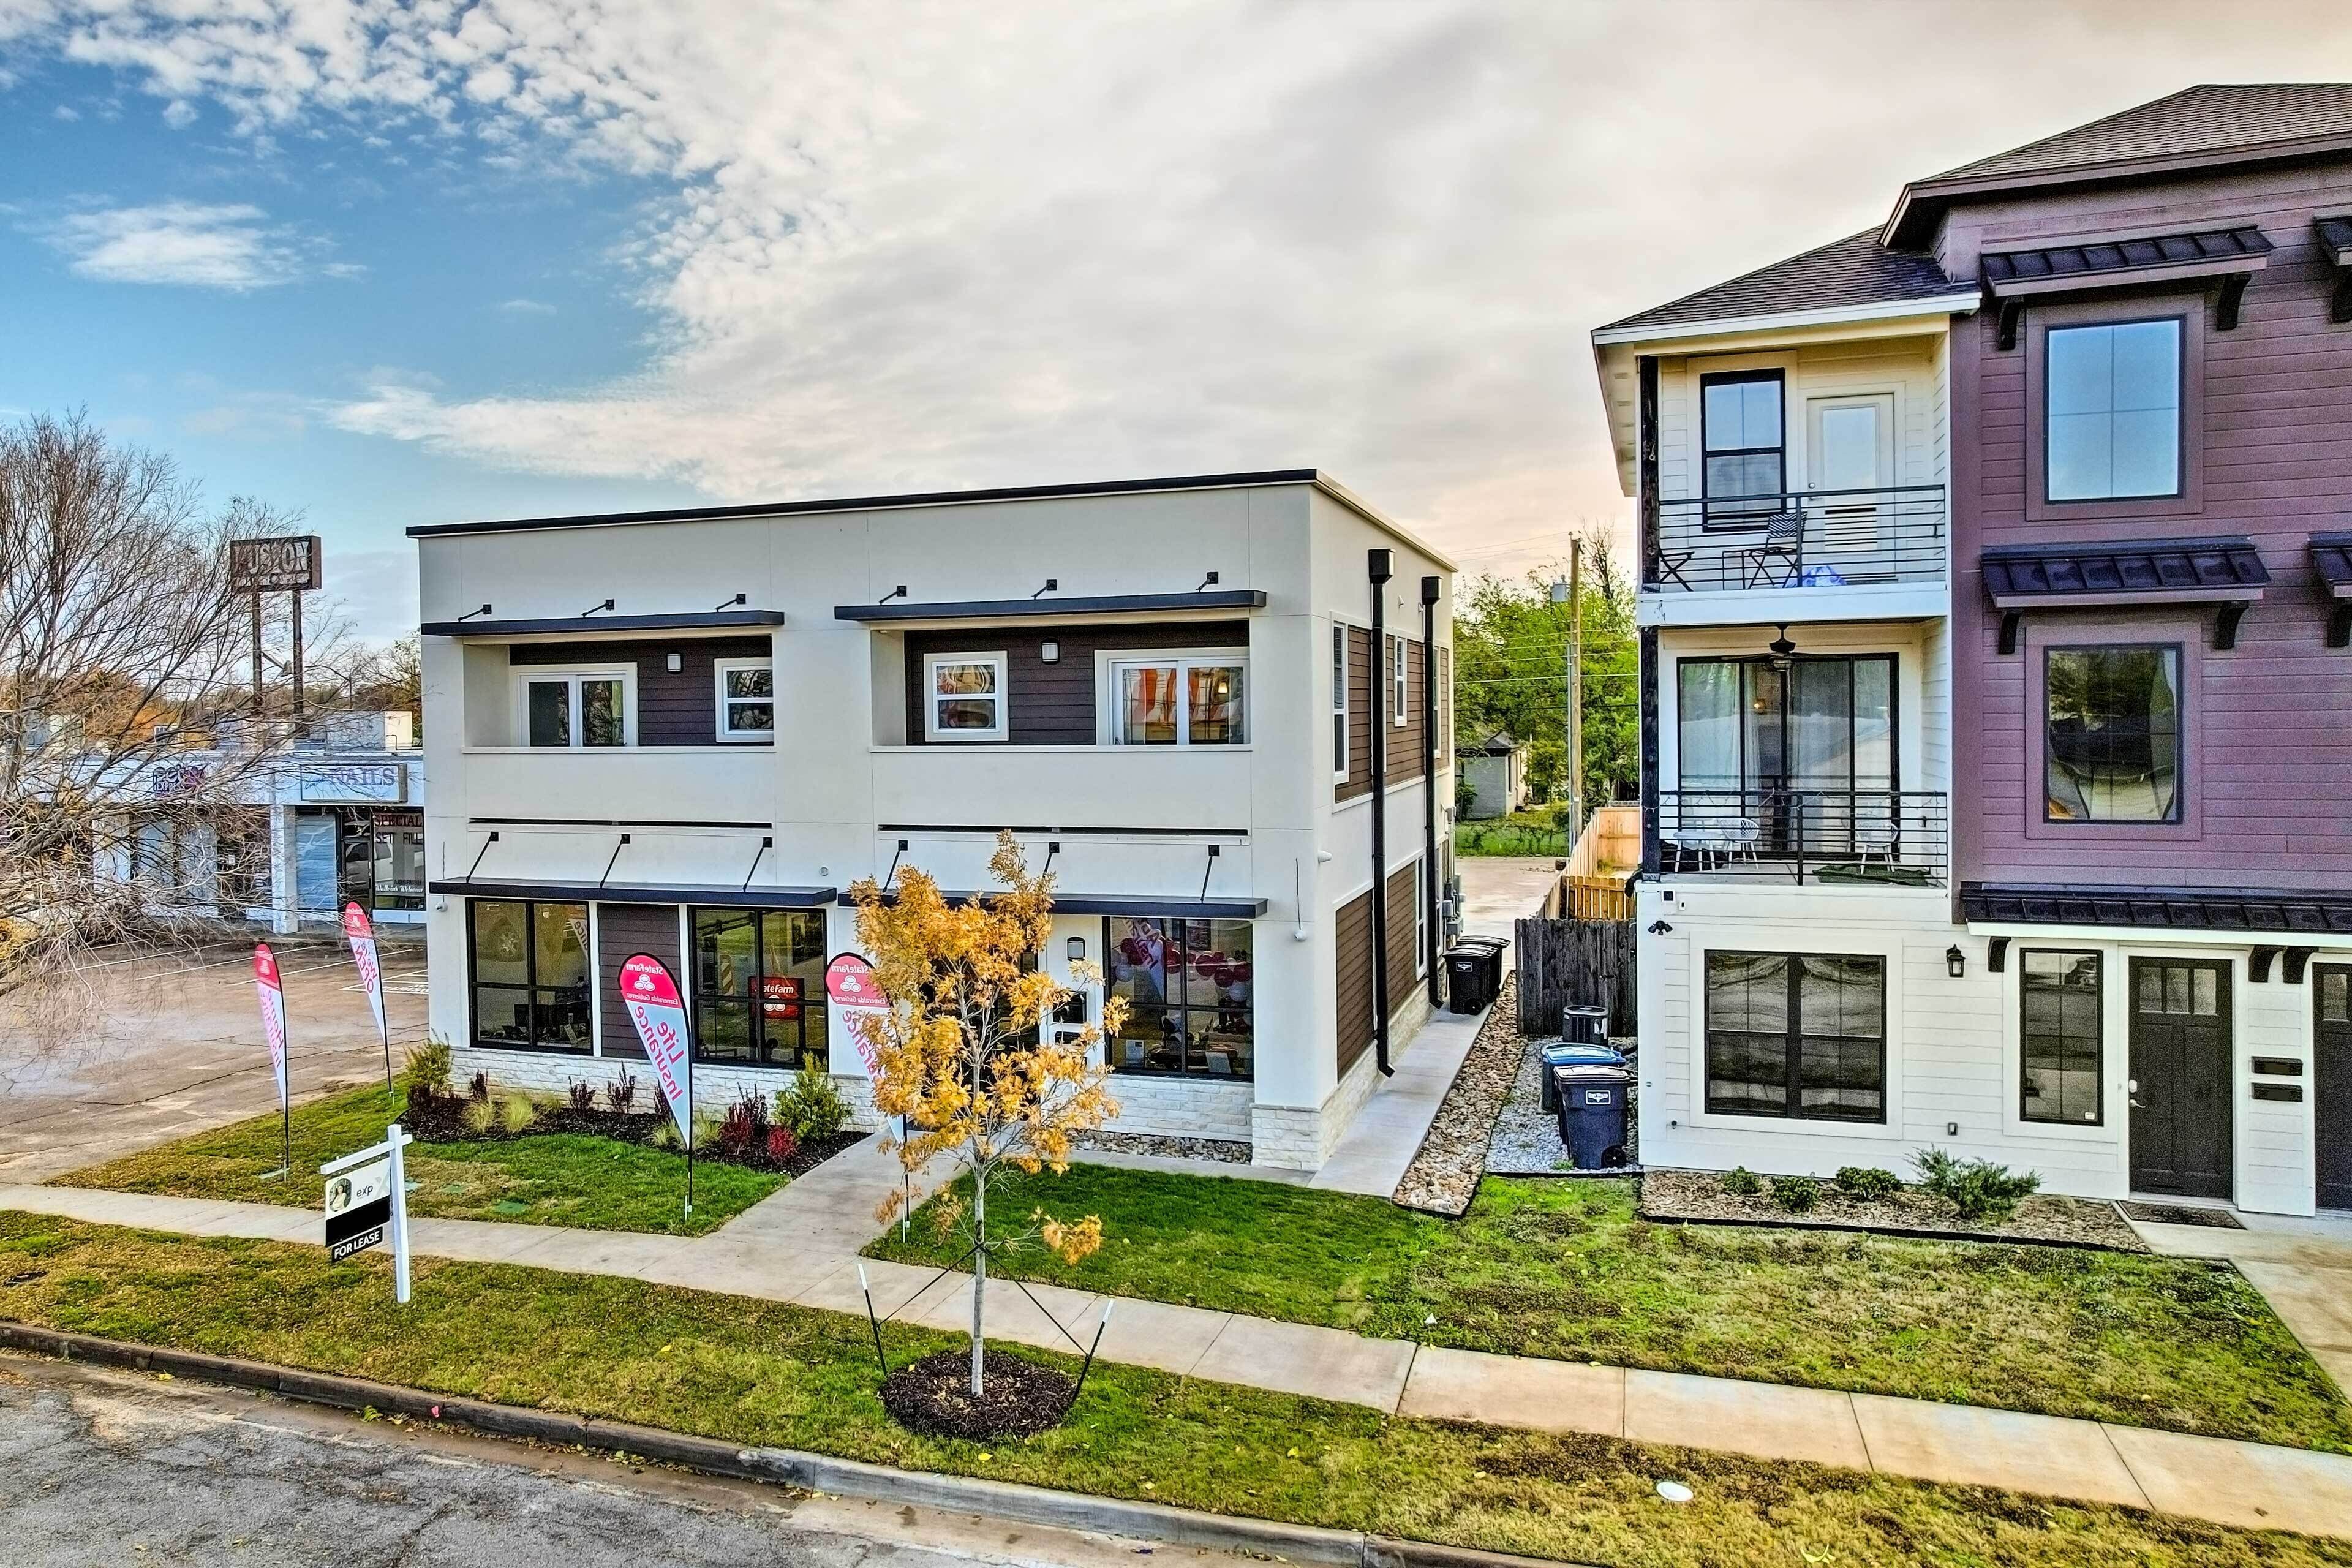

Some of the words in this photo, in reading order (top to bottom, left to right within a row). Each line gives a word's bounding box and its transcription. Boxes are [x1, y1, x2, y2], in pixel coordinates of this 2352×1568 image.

[375, 832, 396, 844] SET
[334, 1244, 353, 1259] FOR
[353, 1231, 380, 1250] LEASE
